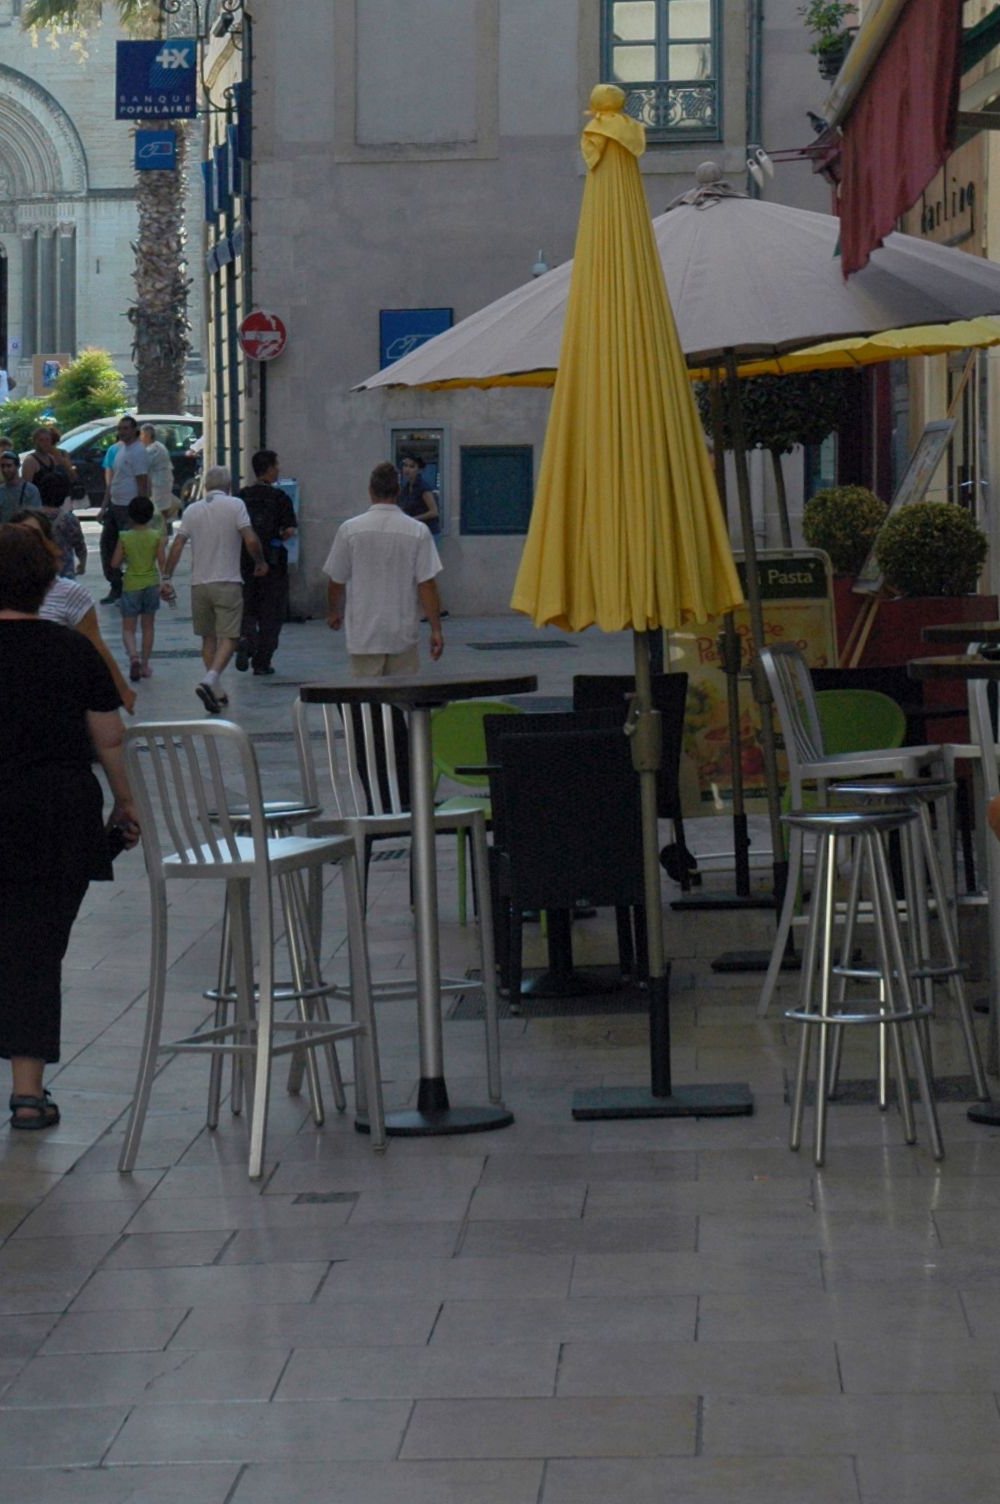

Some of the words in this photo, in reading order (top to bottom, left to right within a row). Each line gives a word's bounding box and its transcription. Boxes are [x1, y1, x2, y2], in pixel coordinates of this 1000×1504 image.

[119, 95, 192, 104] BANQUE
[119, 106, 191, 114] POPULAIRE
[767, 569, 814, 584] Pasta
